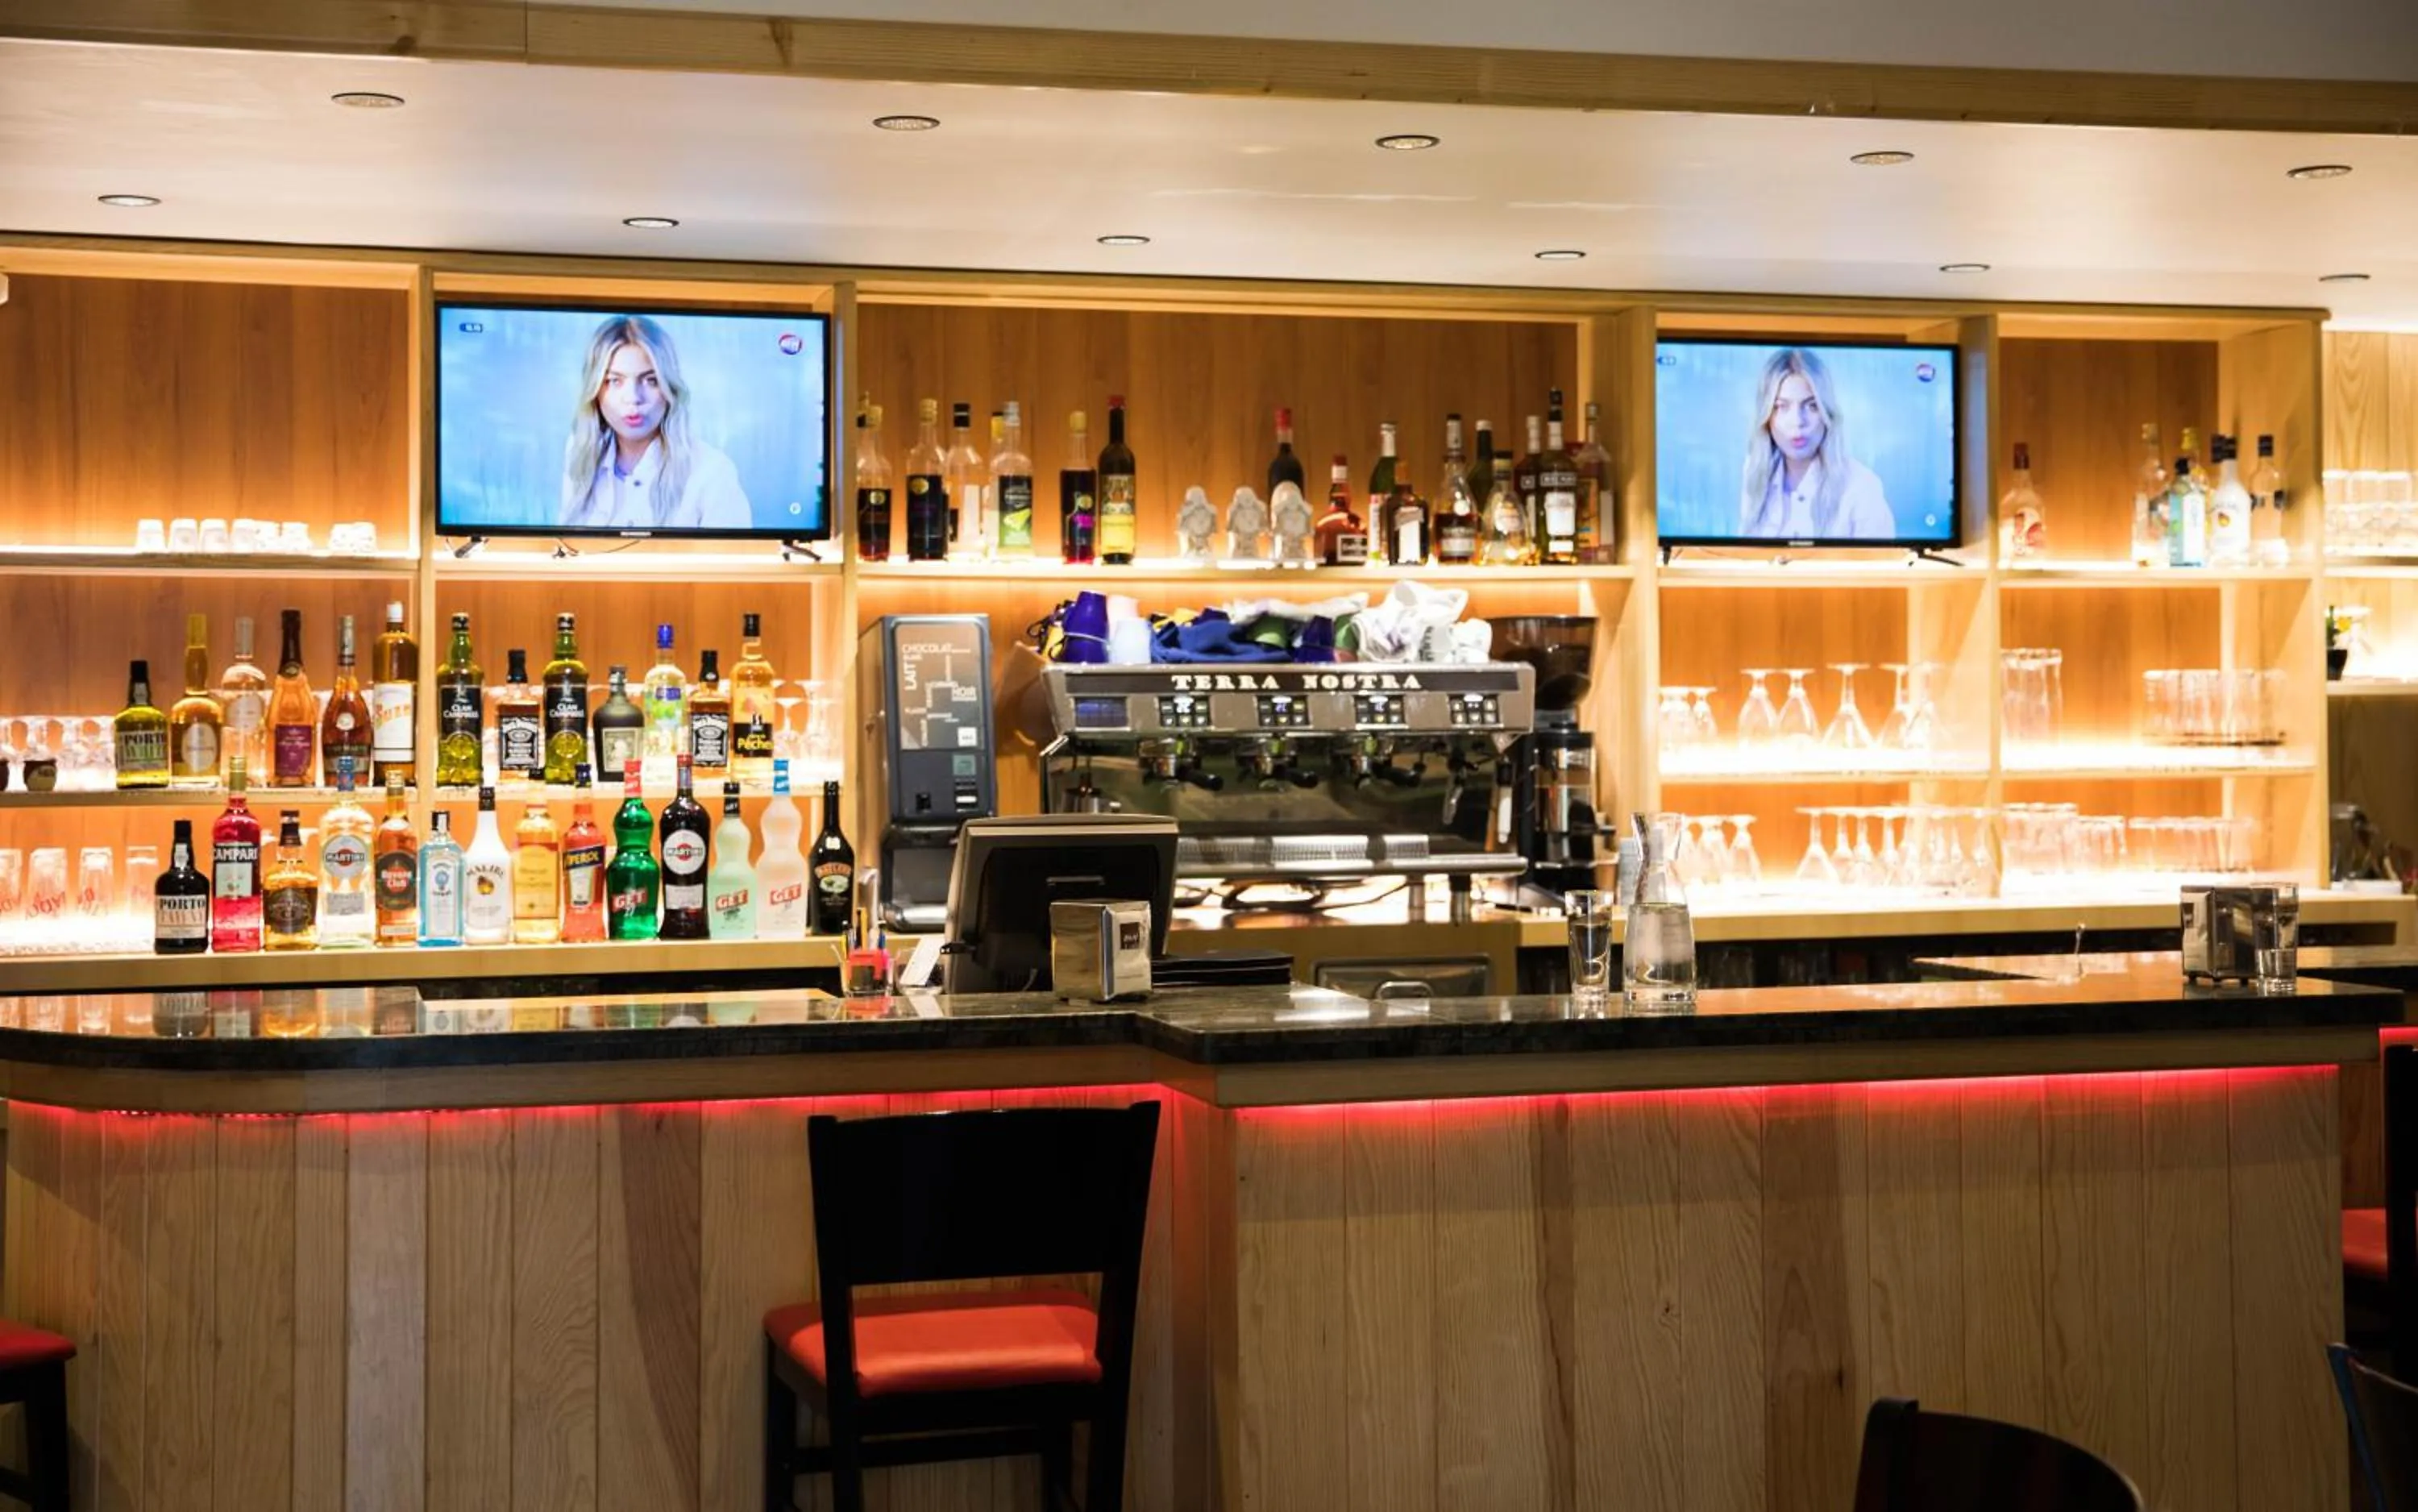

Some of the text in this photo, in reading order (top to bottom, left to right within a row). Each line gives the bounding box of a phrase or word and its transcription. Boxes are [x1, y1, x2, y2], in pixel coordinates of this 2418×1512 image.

[902, 643, 952, 654] CHOCOLAT
[904, 661, 917, 691] LAIT
[1170, 674, 1422, 690] TERRA NOSTRA
[213, 847, 258, 860] CAMPARI
[717, 891, 748, 908] GET
[771, 885, 802, 903] GET
[160, 898, 206, 910] PORTO
